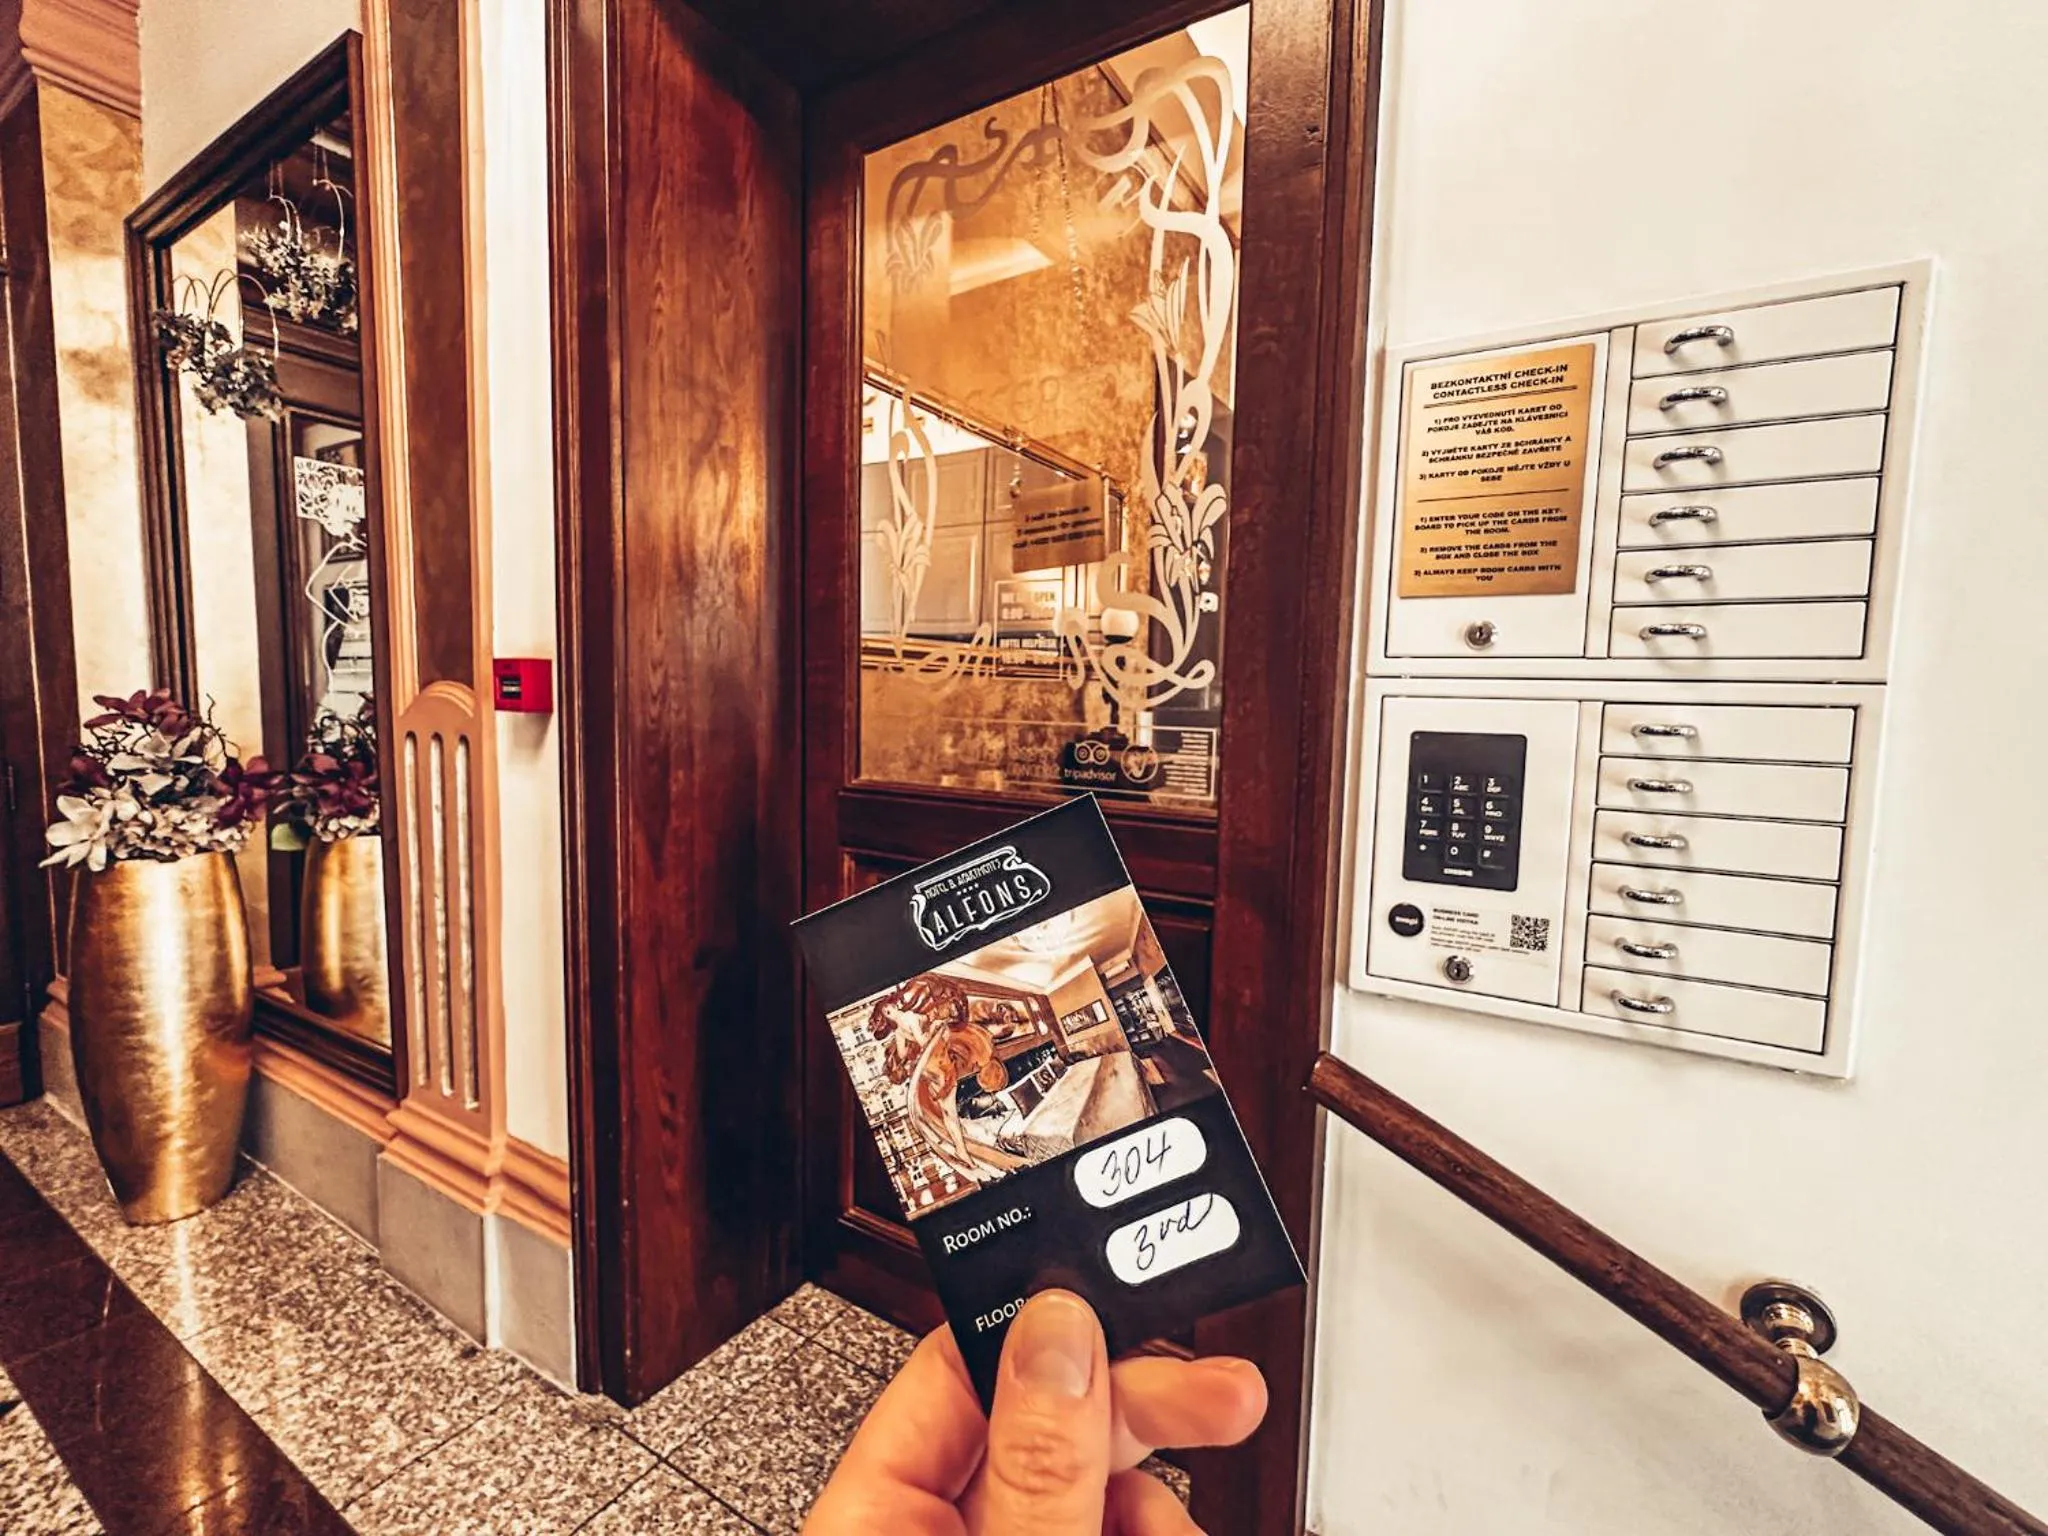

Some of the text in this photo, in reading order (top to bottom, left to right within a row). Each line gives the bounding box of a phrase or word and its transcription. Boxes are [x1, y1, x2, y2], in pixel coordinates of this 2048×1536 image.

[1431, 364, 1568, 390] BEZKONTAKTNÍ CHECK-IN
[1433, 375, 1564, 399] CONTACTLESS CHECK-IN
[1519, 406, 1546, 414] KARET
[1428, 424, 1459, 432] POKOJE
[1462, 420, 1498, 429] ZADEJTE
[1471, 467, 1504, 475] POKOJE
[1511, 517, 1539, 525] CARDS
[1424, 775, 1428, 784] 1
[1454, 776, 1461, 784] 2
[1488, 778, 1494, 787] 3
[1421, 797, 1428, 805] 4
[1453, 799, 1460, 807] 5
[1486, 801, 1493, 810] 6
[1421, 820, 1427, 828] 7
[1452, 823, 1459, 831] 8
[1484, 825, 1492, 834] 9
[934, 874, 1031, 936] ALFONS
[1101, 1131, 1172, 1196] 304
[943, 1206, 1032, 1254] ROOM NO.:
[1134, 1192, 1213, 1270] 3rd
